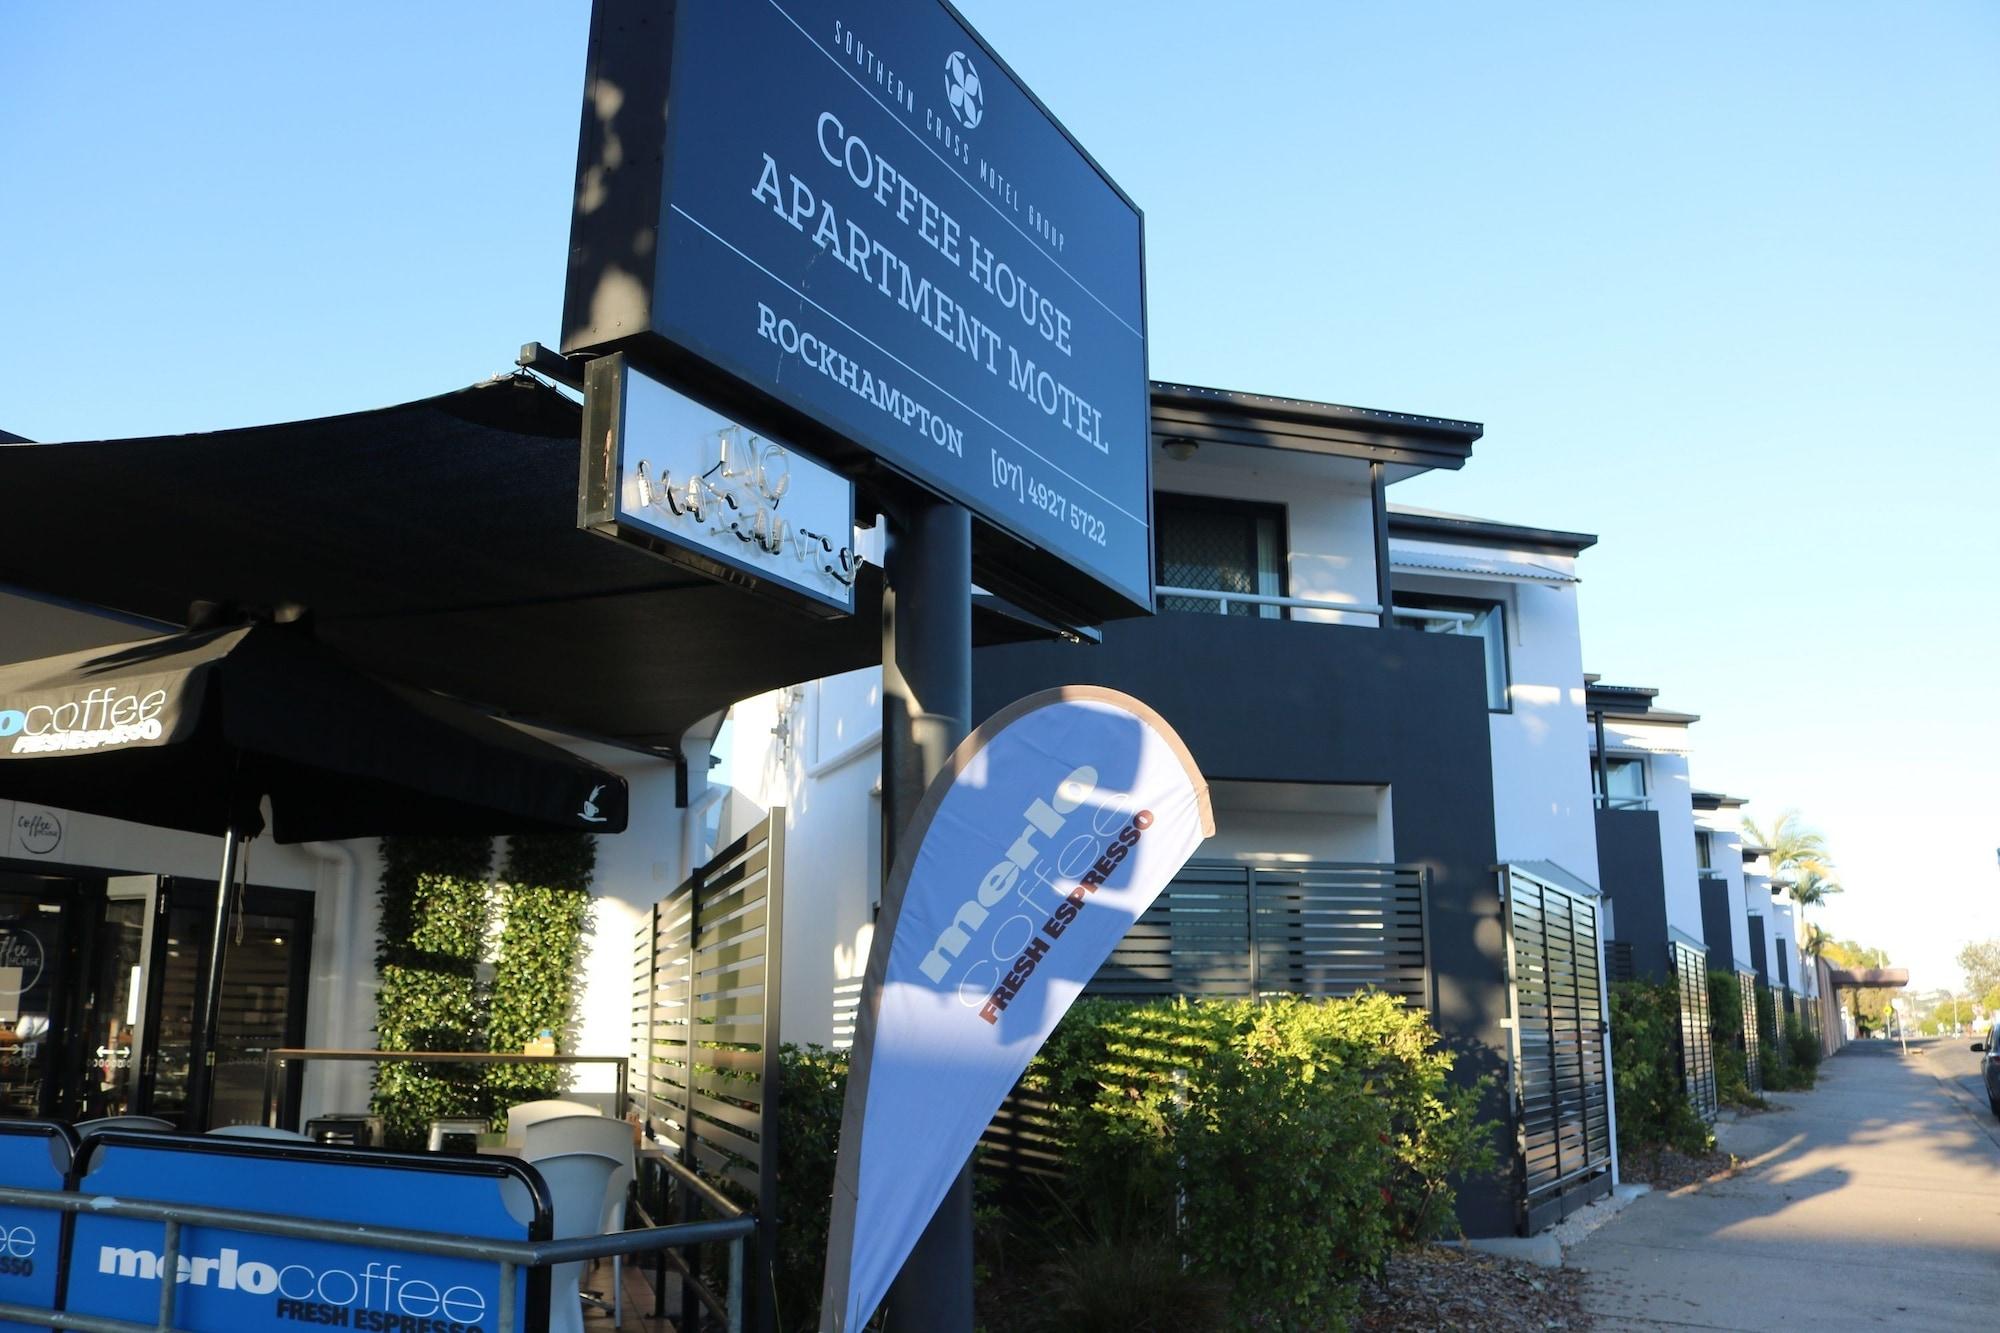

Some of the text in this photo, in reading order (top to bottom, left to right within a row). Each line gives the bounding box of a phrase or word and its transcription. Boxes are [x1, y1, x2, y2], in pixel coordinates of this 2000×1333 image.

[817, 111, 1072, 357] COFFEE HOUSE
[835, 20, 1064, 253] SOUTHERN CROSS MOTEL GROUP
[751, 152, 1110, 455] APARTMENT MOTEL
[757, 301, 964, 458] ROCKHAMPTON
[1028, 478, 1067, 521] 4927
[1070, 506, 1107, 547] 5722
[918, 765, 1099, 985] merlo
[958, 792, 1134, 1008] coffee
[978, 808, 1154, 1026] FRESH ESPRESSO
[276, 1298, 349, 1328] FRESH
